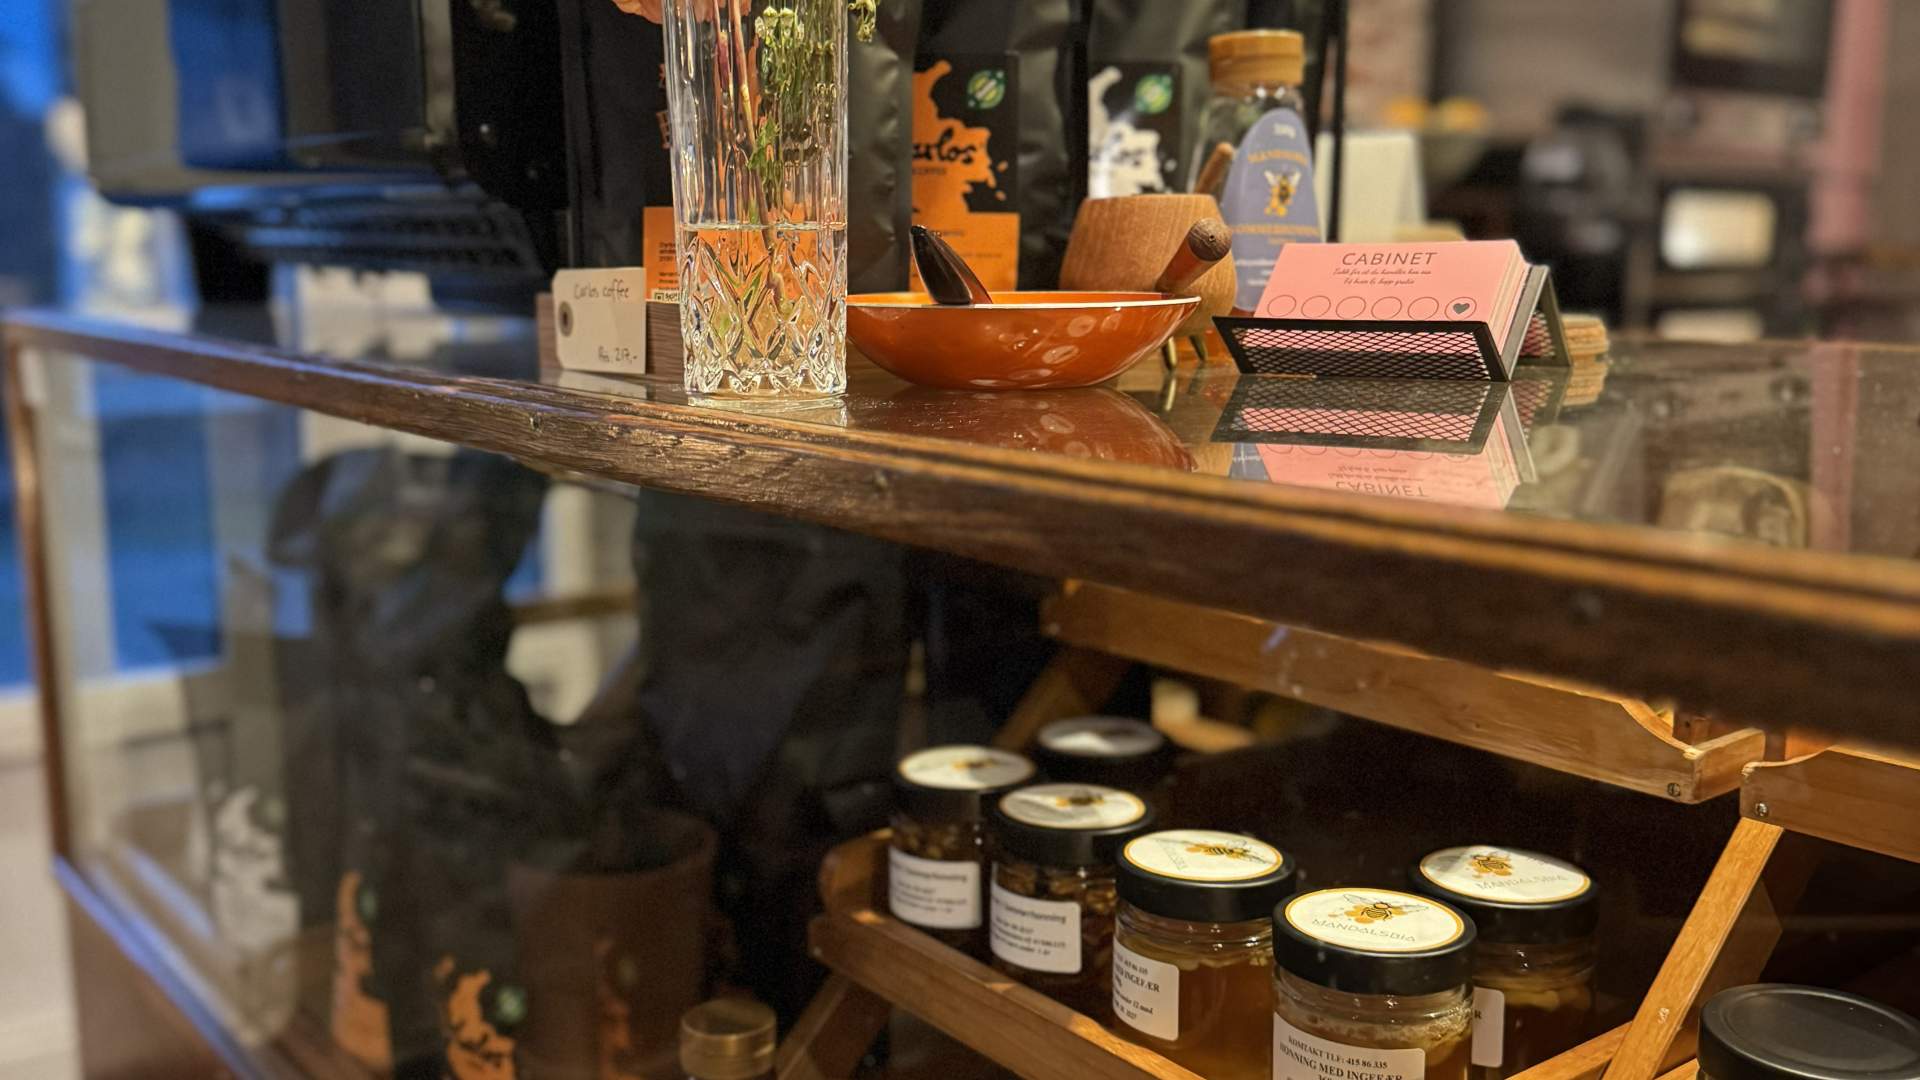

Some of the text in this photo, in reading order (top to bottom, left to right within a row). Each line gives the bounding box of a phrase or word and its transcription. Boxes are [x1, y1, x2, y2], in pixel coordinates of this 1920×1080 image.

[1342, 252, 1438, 265] CABINET
[602, 278, 630, 303] coffee
[1312, 919, 1417, 943] MANDALSBIA
[1345, 1057, 1360, 1066] 415
[1318, 1063, 1344, 1077] MED
